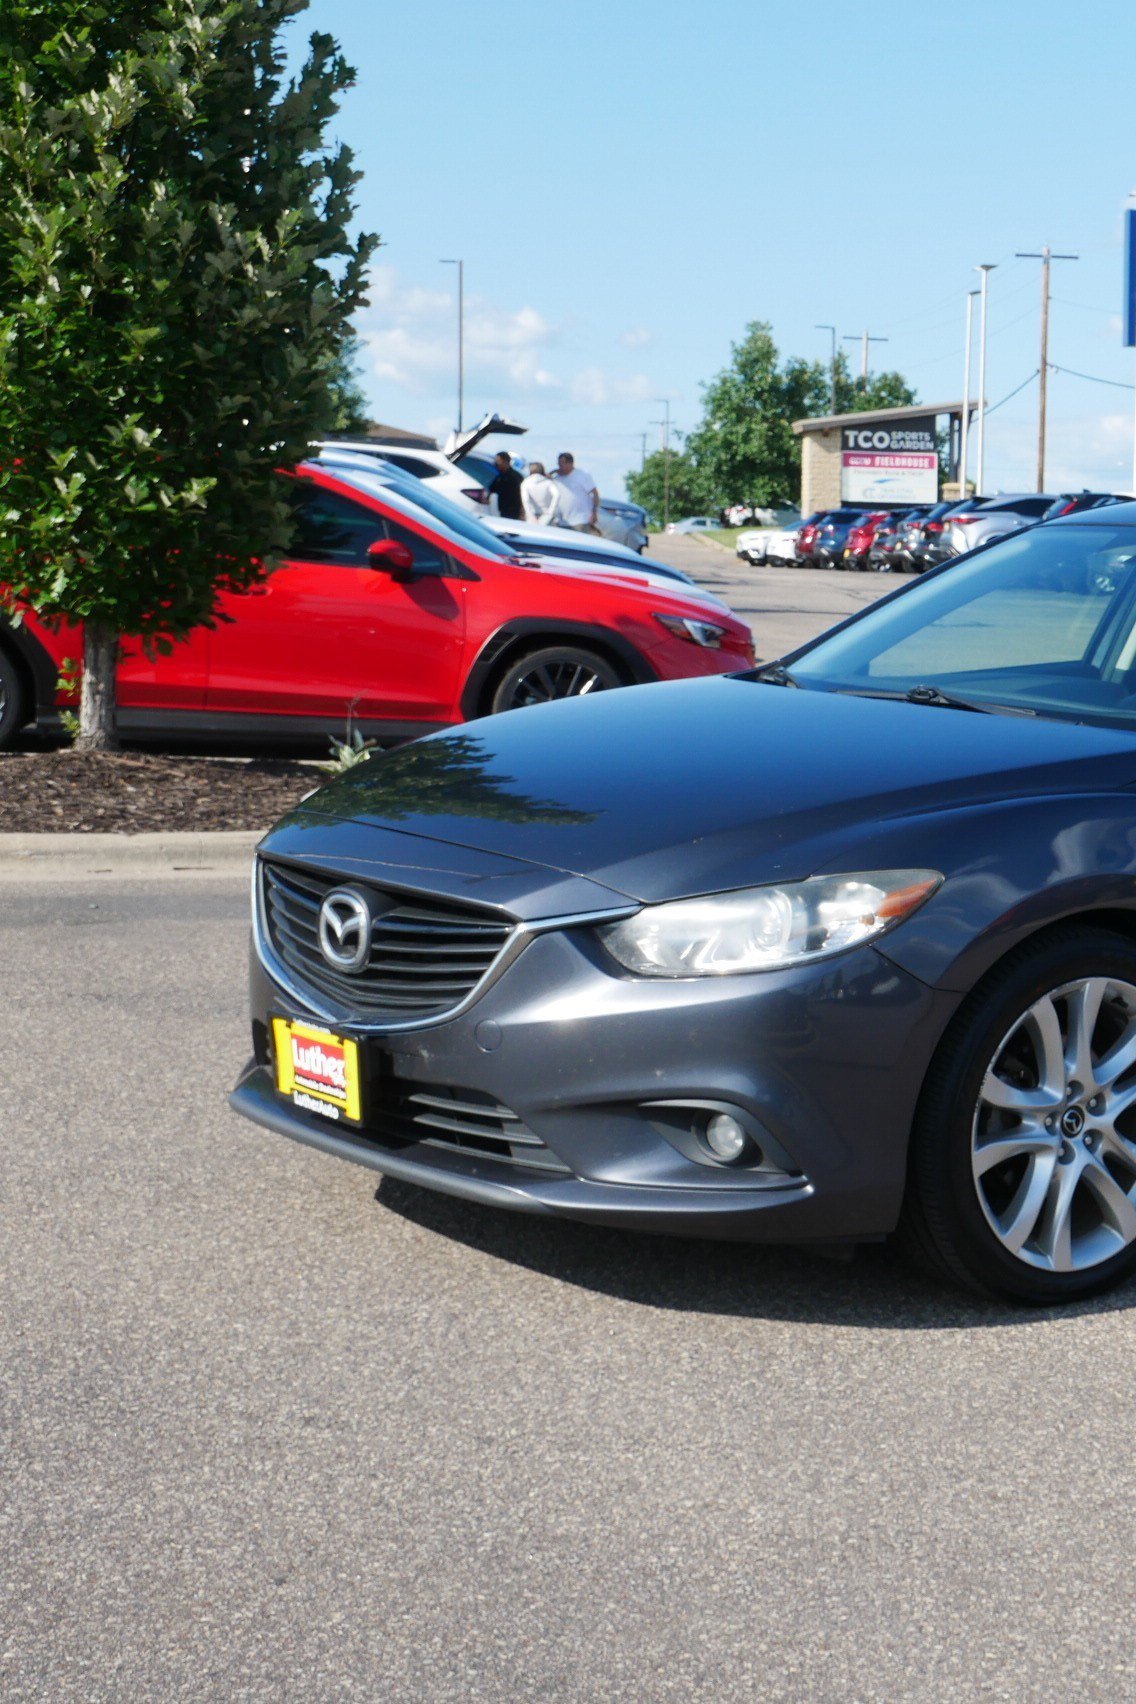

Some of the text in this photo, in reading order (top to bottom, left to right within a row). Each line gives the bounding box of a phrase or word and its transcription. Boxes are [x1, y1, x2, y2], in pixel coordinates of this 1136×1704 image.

[844, 430, 931, 449] TCO SPORTS
[889, 439, 935, 450] GARDEN
[874, 456, 930, 468] FIELDHOUSE
[292, 1038, 346, 1080] Luther
